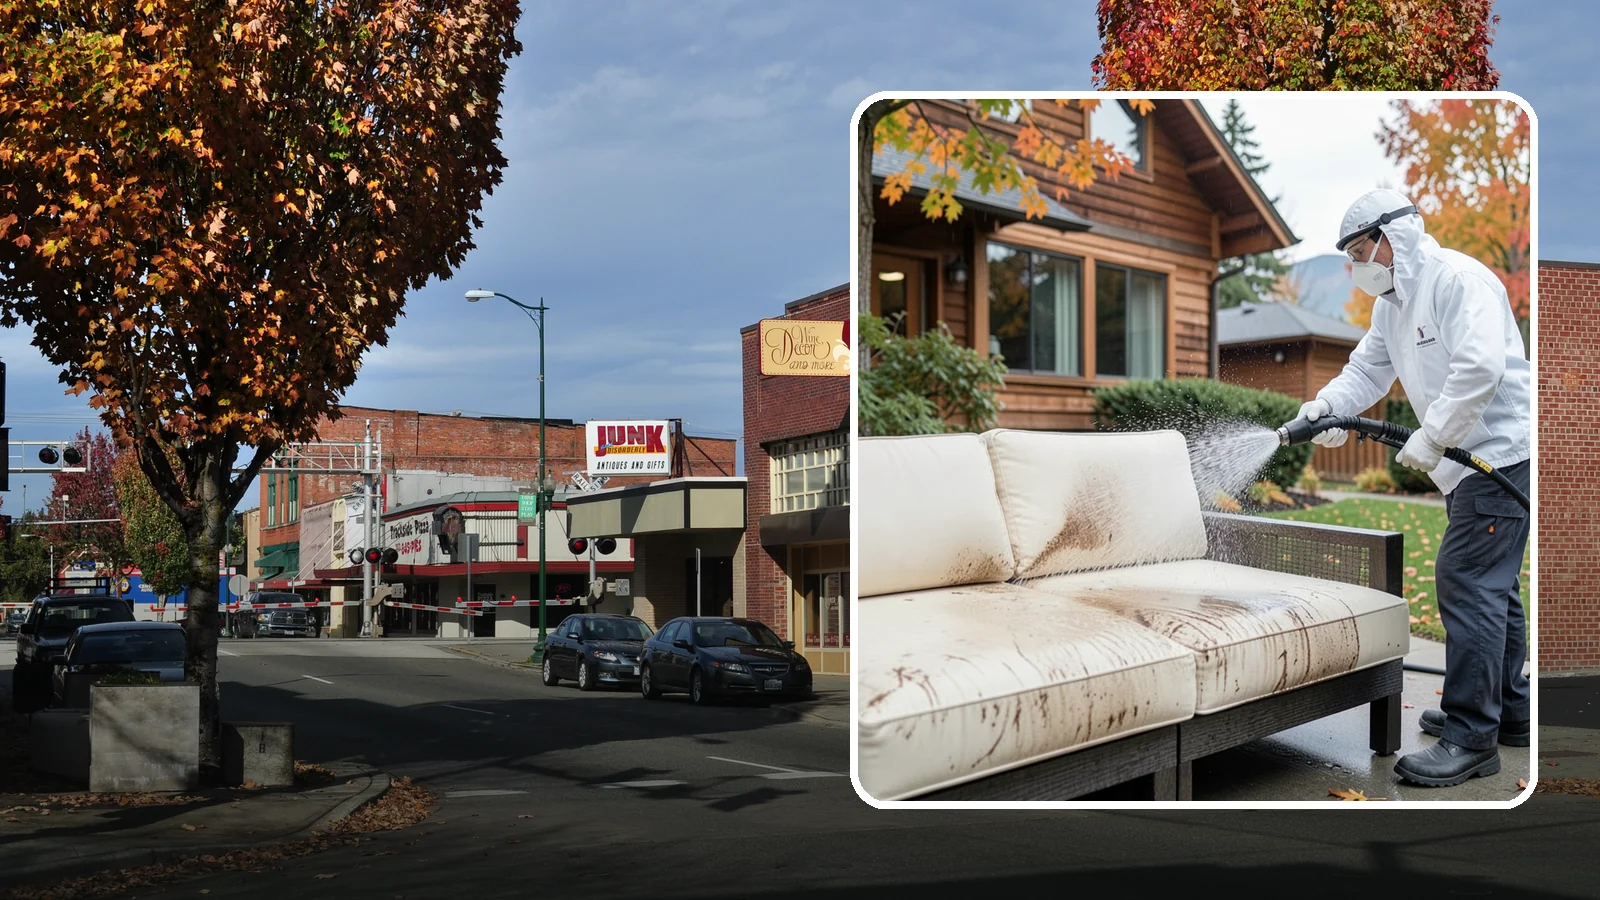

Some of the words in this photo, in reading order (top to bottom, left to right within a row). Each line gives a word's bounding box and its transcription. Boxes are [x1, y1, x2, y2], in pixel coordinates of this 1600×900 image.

[595, 425, 665, 457] JUNK
[607, 446, 646, 454] DISORDERLY
[597, 461, 628, 470] ANTIQUES
[631, 461, 644, 470] AND
[647, 460, 665, 470] GIFTS
[352, 498, 365, 511] CRO
[414, 519, 429, 535] Pizza
